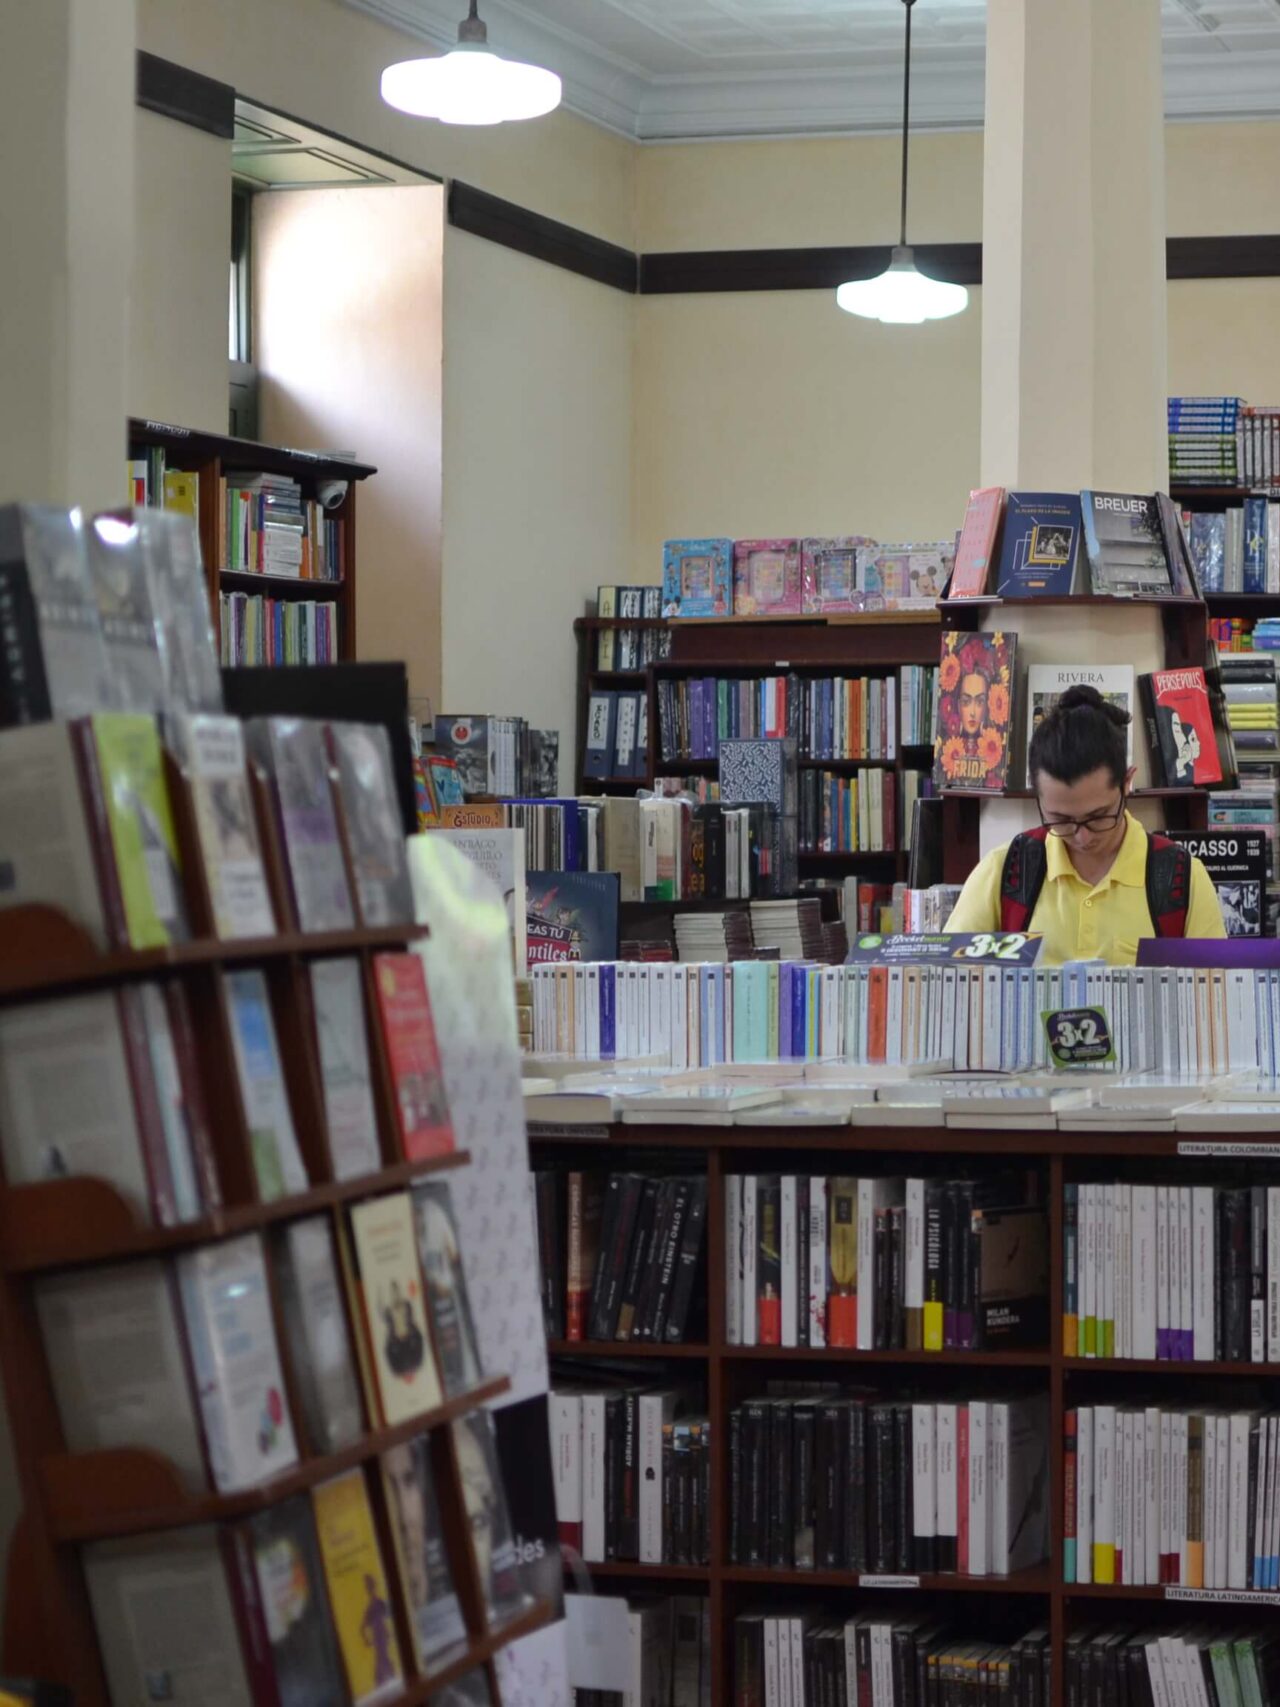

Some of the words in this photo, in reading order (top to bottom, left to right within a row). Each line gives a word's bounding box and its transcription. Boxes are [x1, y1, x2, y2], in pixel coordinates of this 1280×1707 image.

[1094, 497, 1148, 514] BREUER
[1057, 672, 1104, 683] RIVERA
[1156, 668, 1203, 693] PERSÉPOLIS
[953, 759, 986, 778] FRIDA
[965, 934, 1028, 959] 3x2
[1057, 1018, 1100, 1049] 3x2
[1179, 1144, 1228, 1153] LITERATURA
[676, 1198, 684, 1207] EL
[928, 1208, 940, 1219] LA
[670, 1211, 681, 1238] OTRO
[928, 1221, 940, 1269] PSICÓLOGA
[662, 1240, 676, 1285] EINSTEIN
[986, 1308, 1009, 1317] MILAN
[986, 1315, 1020, 1326] KUNDERA
[625, 1396, 634, 1433] McKINTY
[625, 1434, 633, 1467] ADRIAN
[1167, 1589, 1216, 1601] LITERATURA
